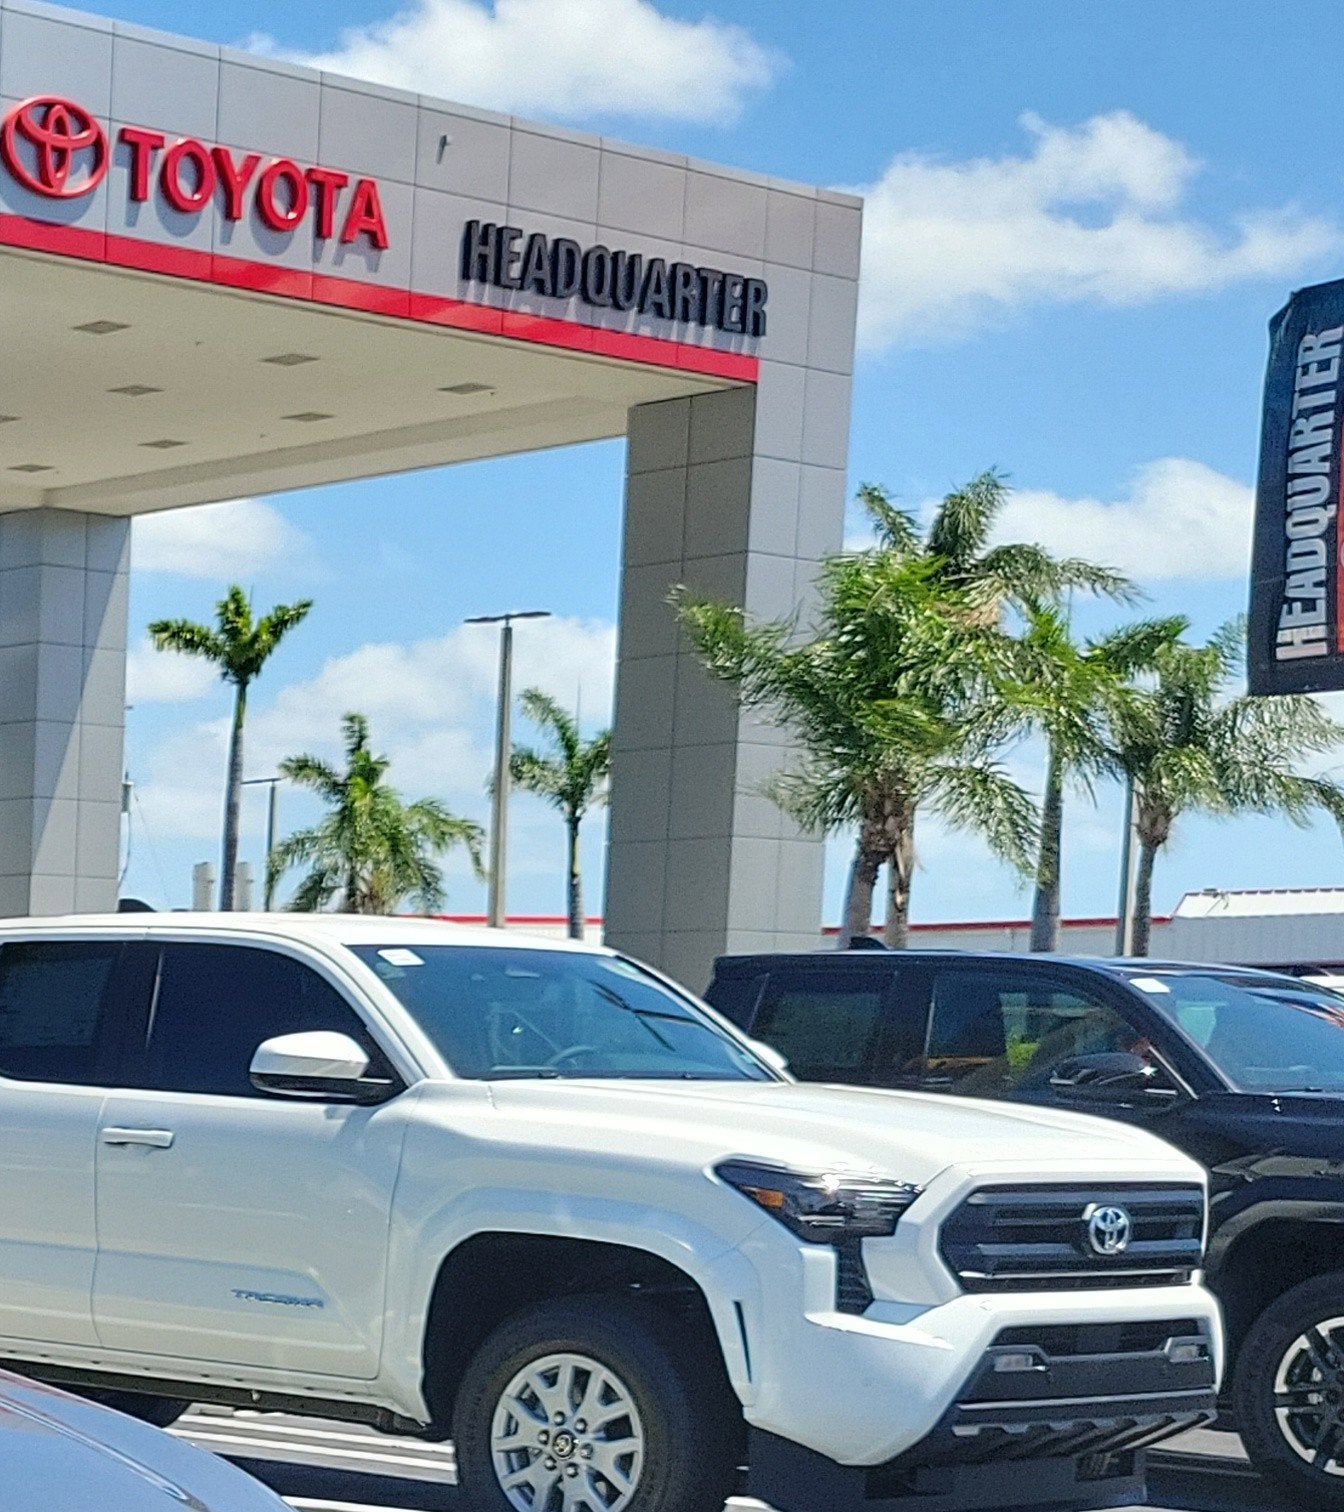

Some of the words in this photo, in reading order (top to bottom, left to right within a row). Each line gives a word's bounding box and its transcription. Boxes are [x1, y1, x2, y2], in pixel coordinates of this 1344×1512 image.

[119, 127, 389, 250] TOYOTA
[460, 220, 768, 337] HEADQUARTER
[1275, 325, 1344, 661] HEADQUARTER
